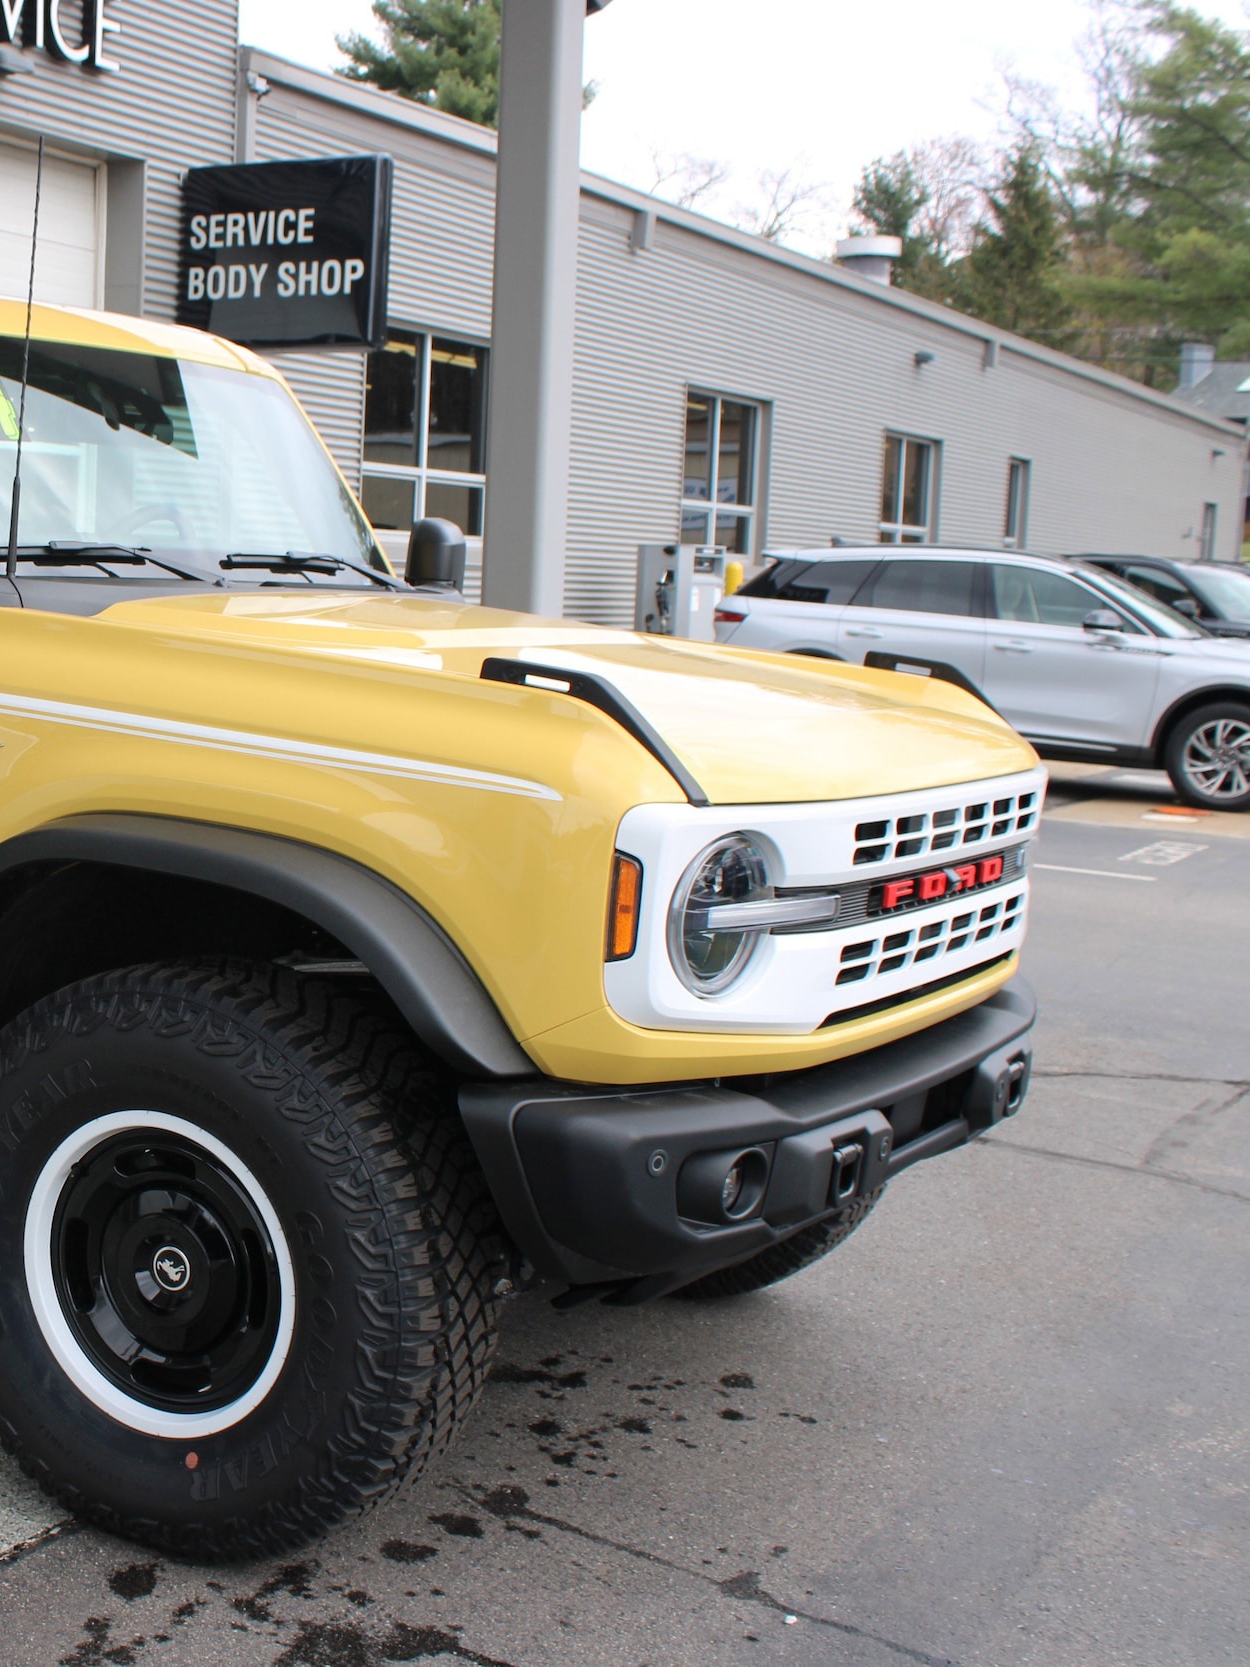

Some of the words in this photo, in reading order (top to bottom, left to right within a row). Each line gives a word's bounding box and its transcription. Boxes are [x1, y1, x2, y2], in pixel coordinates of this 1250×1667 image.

[190, 208, 315, 250] SERVICE
[188, 263, 268, 300] BODY
[277, 258, 364, 297] SHOP
